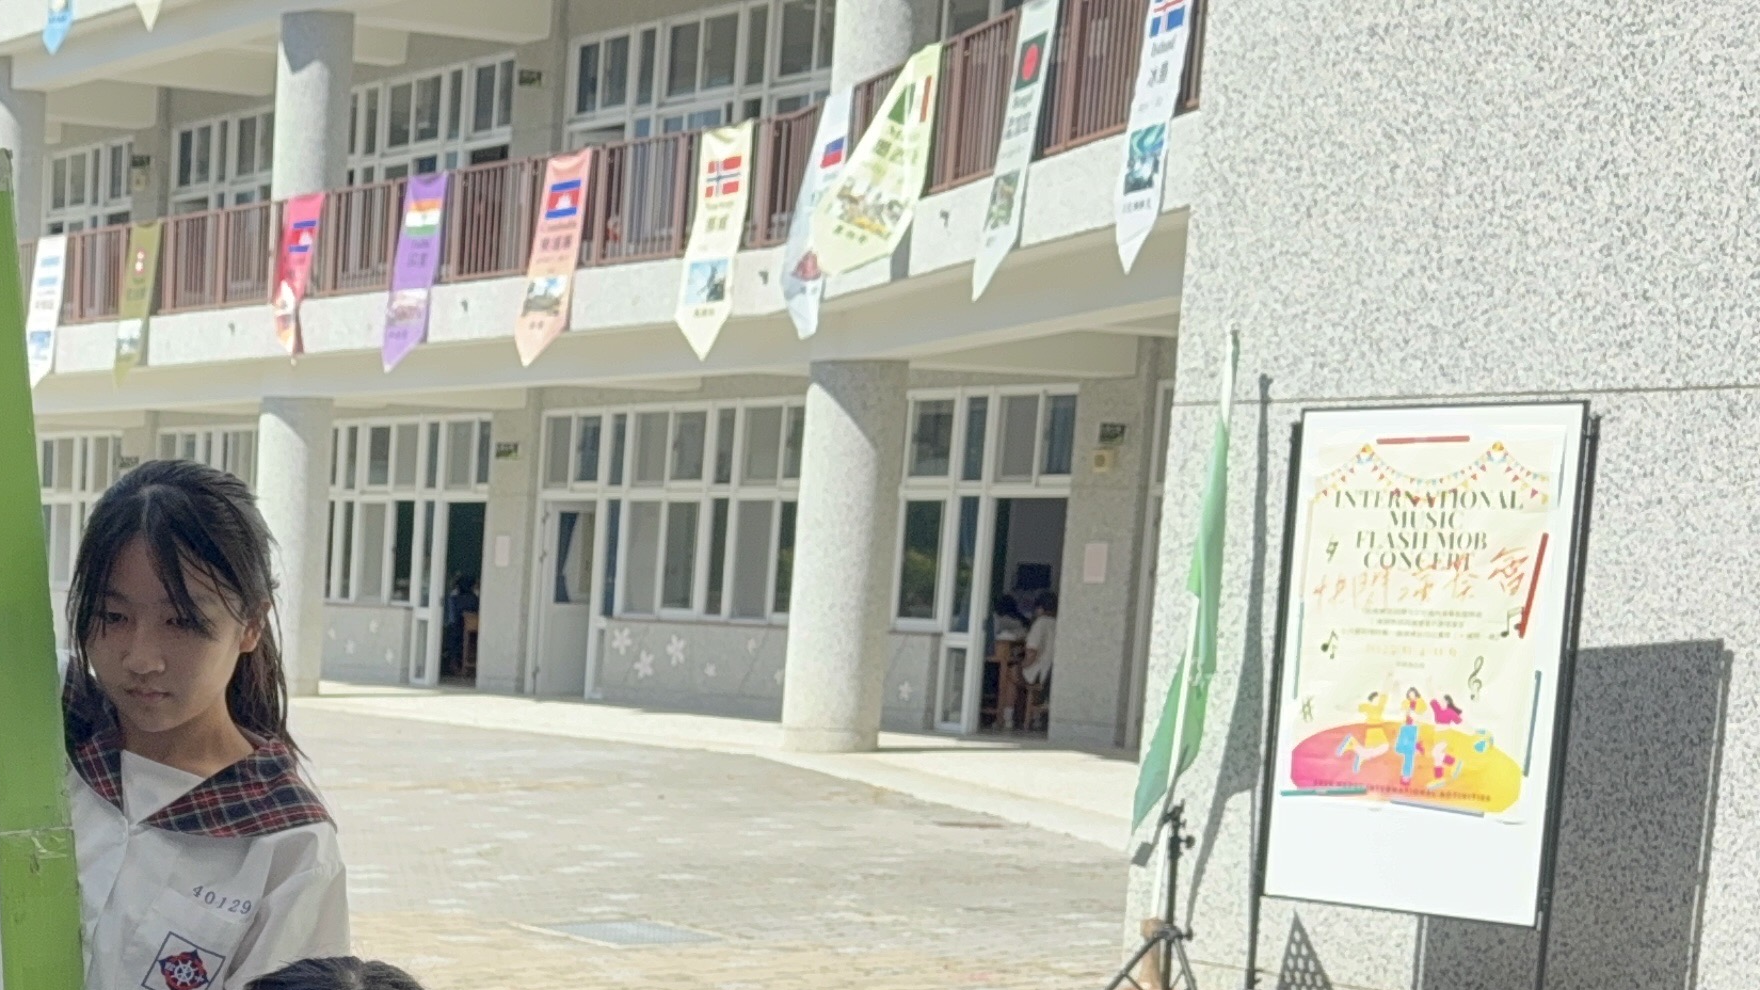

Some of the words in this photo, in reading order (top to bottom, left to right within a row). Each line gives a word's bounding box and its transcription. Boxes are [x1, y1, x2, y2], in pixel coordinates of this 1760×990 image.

[1335, 489, 1525, 510] INTERNATIONAL
[1390, 509, 1464, 529] MUSIC
[1356, 530, 1429, 550] FLASH
[1436, 530, 1488, 550] MOB
[1363, 550, 1471, 571] CONCERT
[193, 885, 252, 915] 40129
